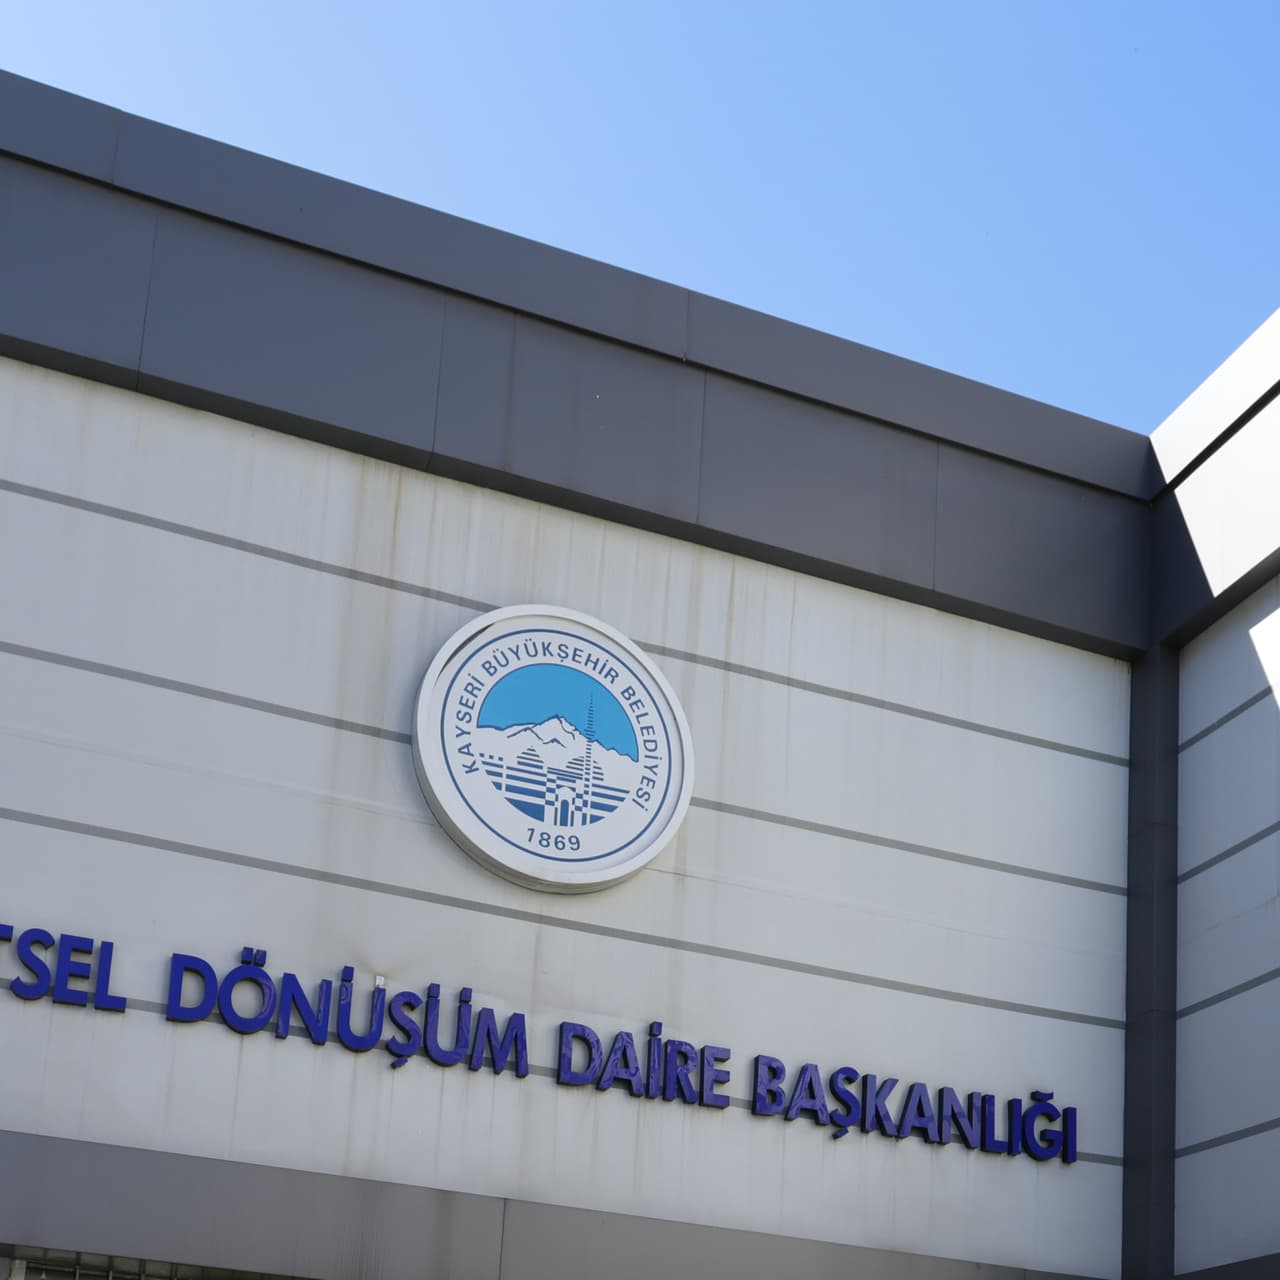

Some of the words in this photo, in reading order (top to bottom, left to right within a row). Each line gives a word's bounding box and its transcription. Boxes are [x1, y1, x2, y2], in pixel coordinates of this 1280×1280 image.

[455, 672, 485, 775] KAYSERİ
[481, 638, 620, 685] BÜYÜKŞEHİR
[620, 686, 663, 812] BELEDİYESİ
[527, 827, 581, 851] 1869
[166, 946, 530, 1078] DÖNÜŞÜM
[556, 1021, 731, 1110] DAİRE
[752, 1053, 1078, 1164] BAŞKANLIĞI
